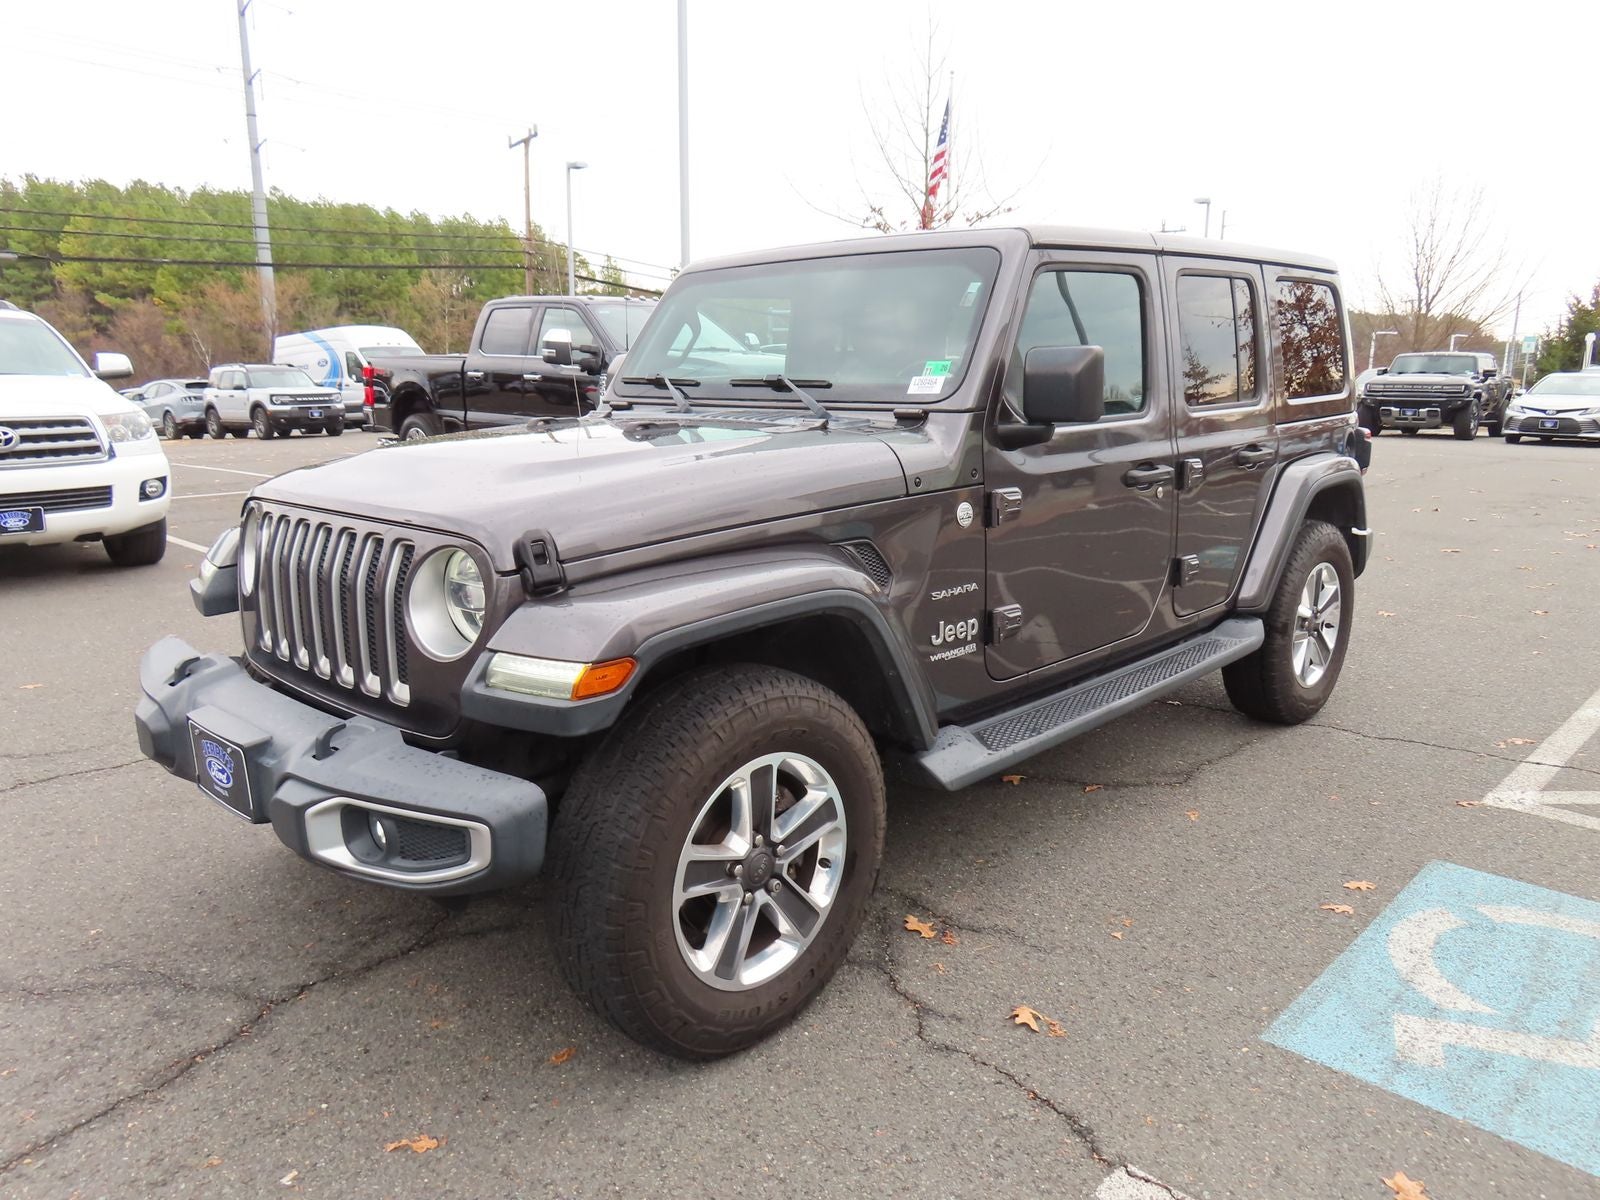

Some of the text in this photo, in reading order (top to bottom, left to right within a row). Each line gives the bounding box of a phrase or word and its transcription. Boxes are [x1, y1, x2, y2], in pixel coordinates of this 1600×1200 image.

[931, 582, 978, 600] SAHARA
[931, 618, 978, 645] Jeep
[930, 643, 976, 661] WRANGLER
[209, 760, 229, 785] Ford
